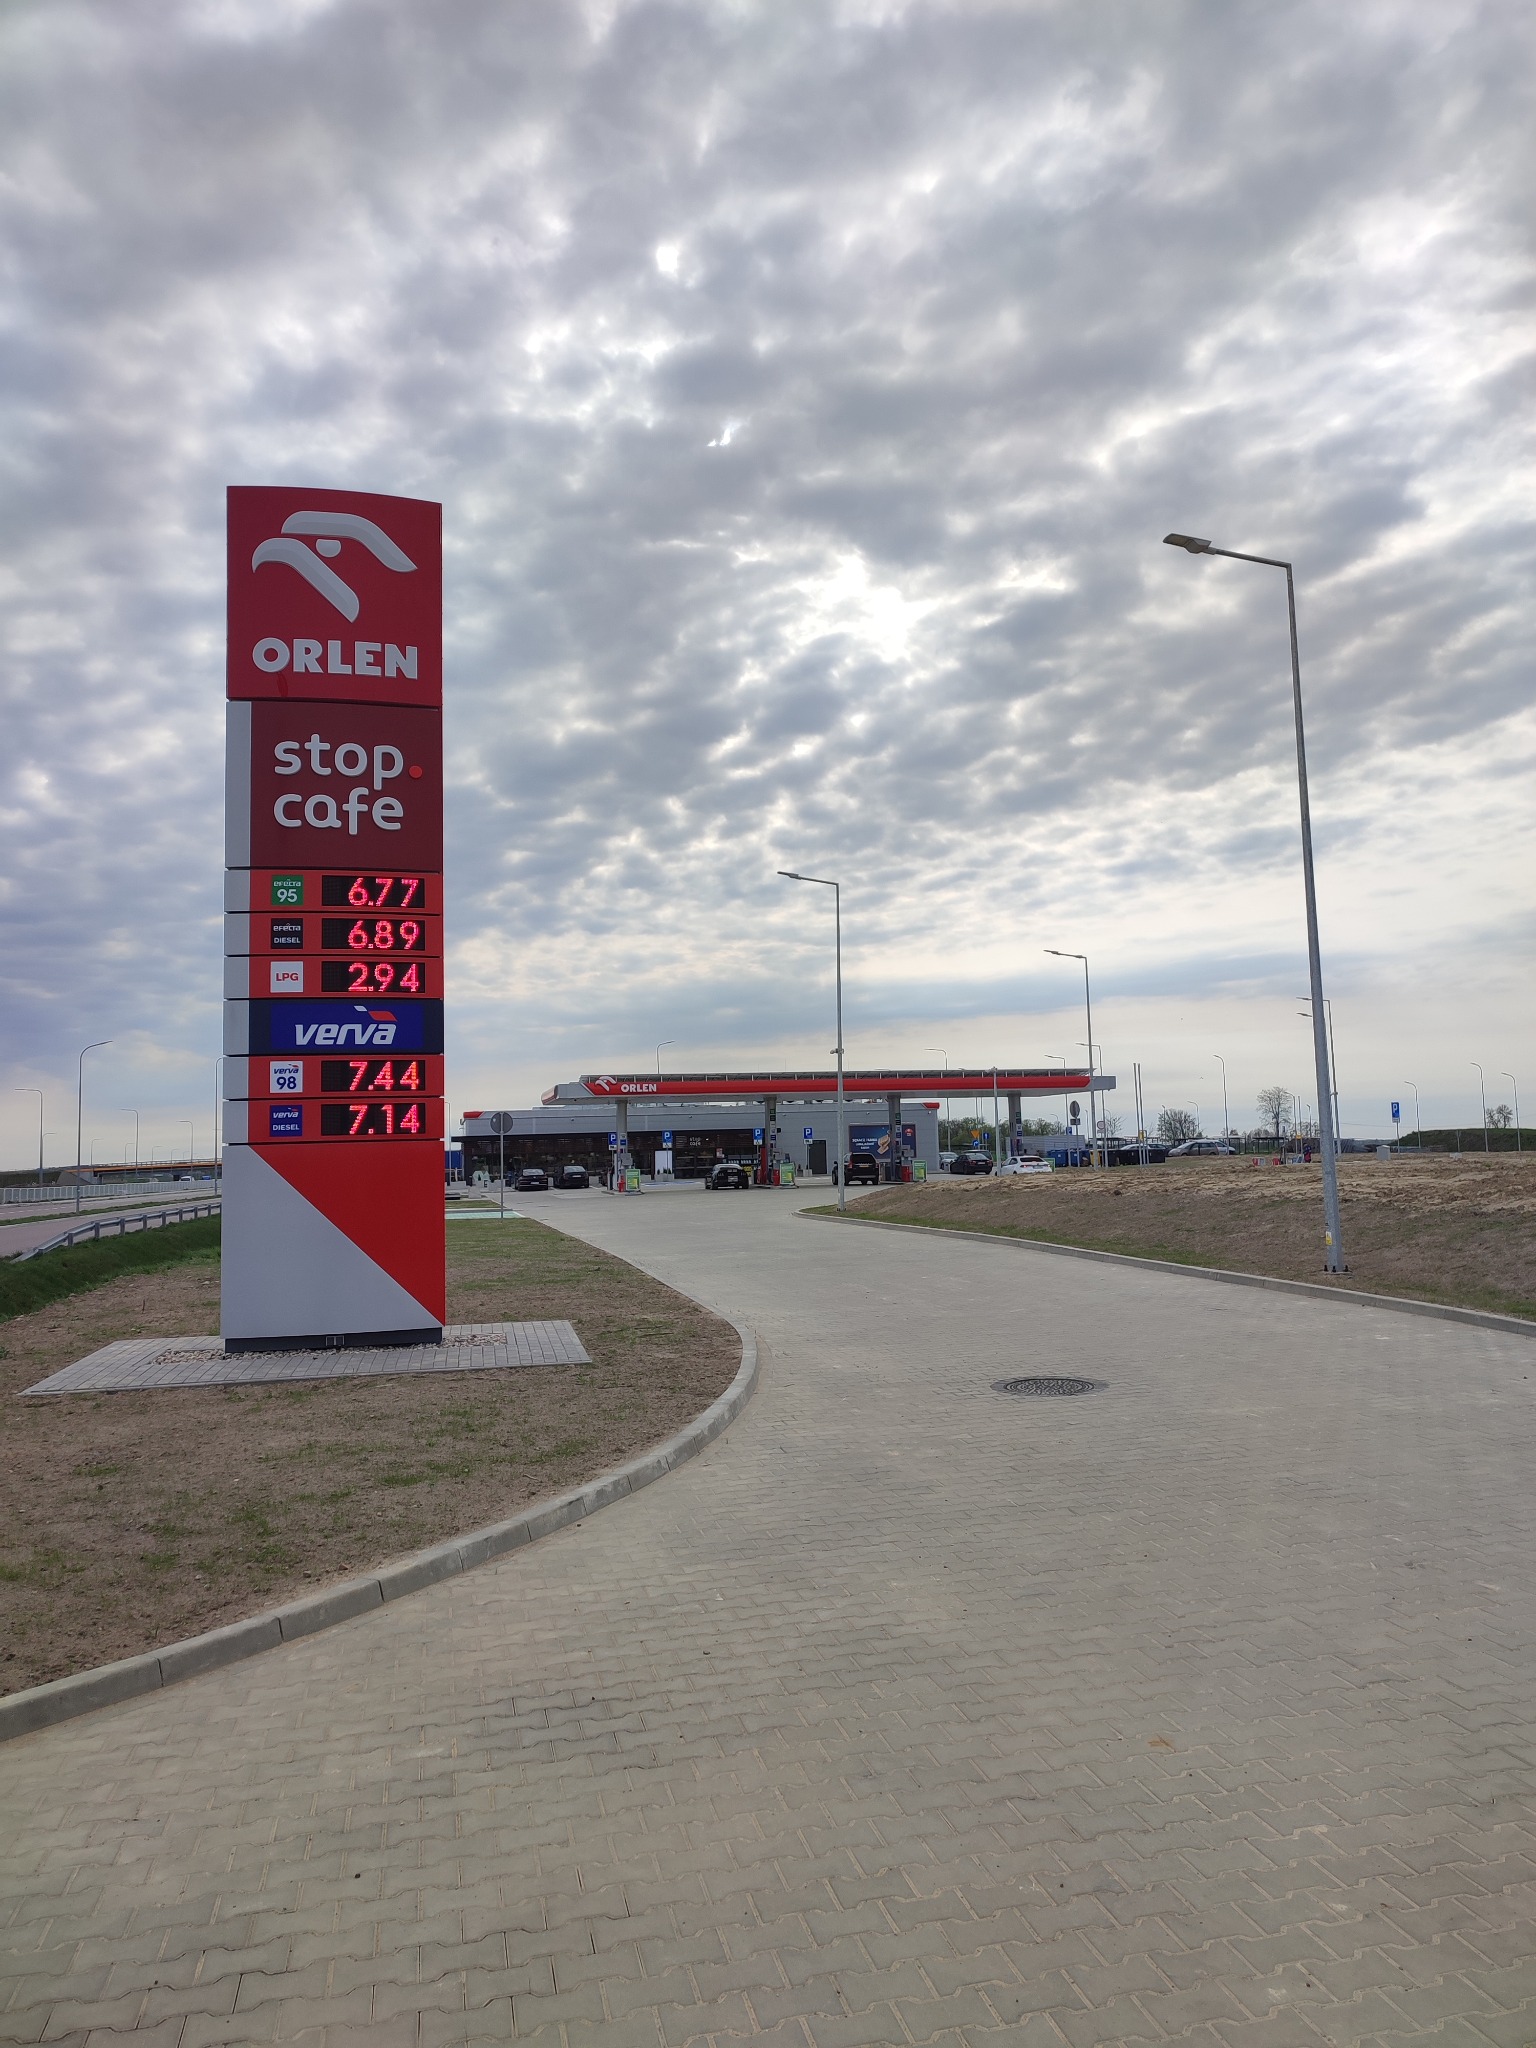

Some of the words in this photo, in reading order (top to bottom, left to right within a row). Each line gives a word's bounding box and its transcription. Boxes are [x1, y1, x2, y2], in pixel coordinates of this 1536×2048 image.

[252, 637, 418, 680] ORLEN
[273, 786, 404, 836] cafe
[277, 889, 298, 903] 95
[347, 877, 419, 907] 6.77
[347, 920, 419, 949] 6.89
[276, 972, 299, 982] LPG
[347, 962, 419, 992] 2.94
[294, 1023, 397, 1046] verva
[276, 1076, 297, 1090] 98
[347, 1061, 419, 1091] 7.44
[620, 1084, 657, 1092] ORLEN
[273, 1111, 299, 1119] verva
[347, 1104, 419, 1135] 7.14
